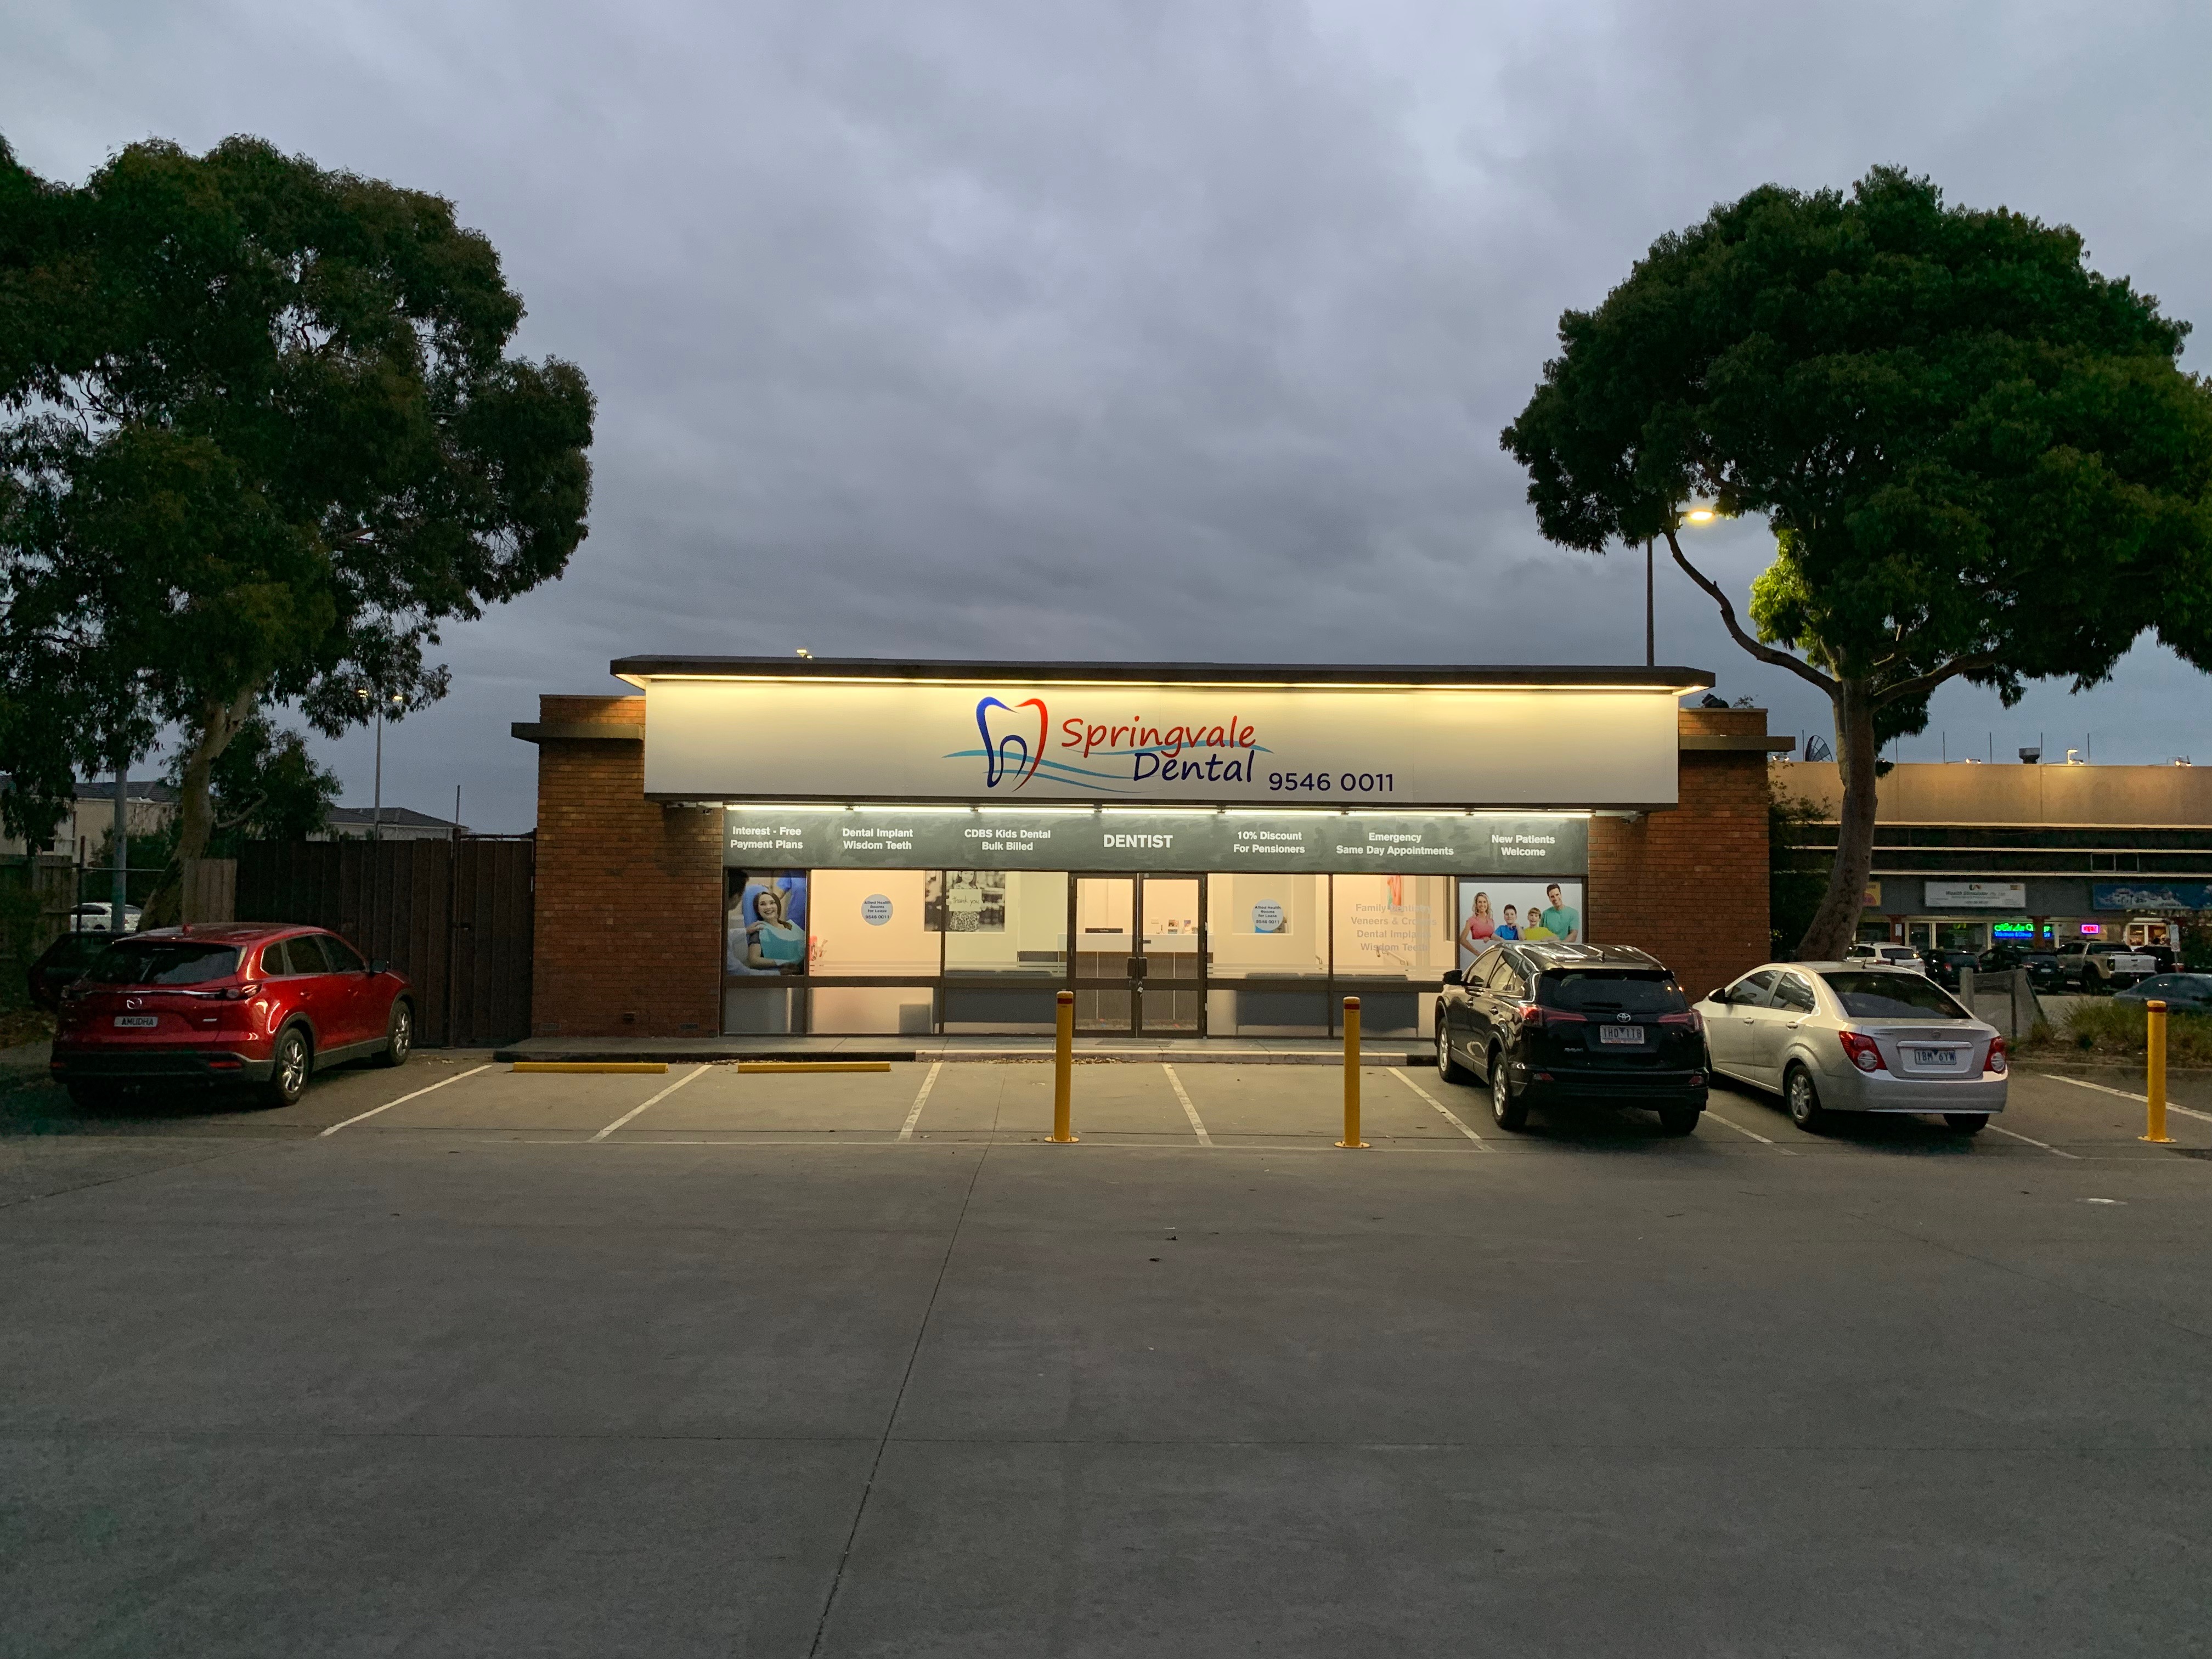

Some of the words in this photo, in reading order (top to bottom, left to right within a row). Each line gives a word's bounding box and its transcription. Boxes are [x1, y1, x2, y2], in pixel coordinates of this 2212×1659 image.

[1062, 715, 1256, 758] Springvale
[1133, 750, 1254, 782] Dental
[1269, 772, 1331, 791] 9546
[1340, 773, 1393, 792] 0011
[732, 826, 770, 835] Interest
[780, 827, 802, 836] Free
[842, 828, 873, 837] Dental
[877, 828, 913, 838] Implant
[964, 829, 992, 838] CDBS
[996, 830, 1017, 838] Kids
[1020, 830, 1051, 839] Dental
[1237, 831, 1257, 840] 10%
[1260, 832, 1302, 840] Discount
[1103, 834, 1173, 848] DENTIST
[1369, 833, 1421, 843] Emergency
[1492, 834, 1513, 843] New
[1515, 835, 1555, 844] Patients
[730, 840, 773, 850] Payment
[776, 840, 803, 849] Plans
[843, 840, 883, 849] Wisdom
[886, 840, 912, 849] Teeth
[981, 842, 1003, 850] Bulk
[1006, 842, 1033, 850] Billed
[1233, 844, 1249, 853] For
[1252, 844, 1305, 854] Pensioners
[1336, 845, 1364, 854] Same
[1367, 845, 1385, 856] Day
[1387, 846, 1454, 856] Appointments
[1501, 847, 1546, 856] Welcome
[952, 895, 967, 904] thank
[1356, 904, 1386, 913] Family
[1351, 917, 1389, 925] Veneers
[1392, 917, 1398, 925] &
[1402, 917, 1437, 926] Cros
[1391, 930, 1431, 939] Impla
